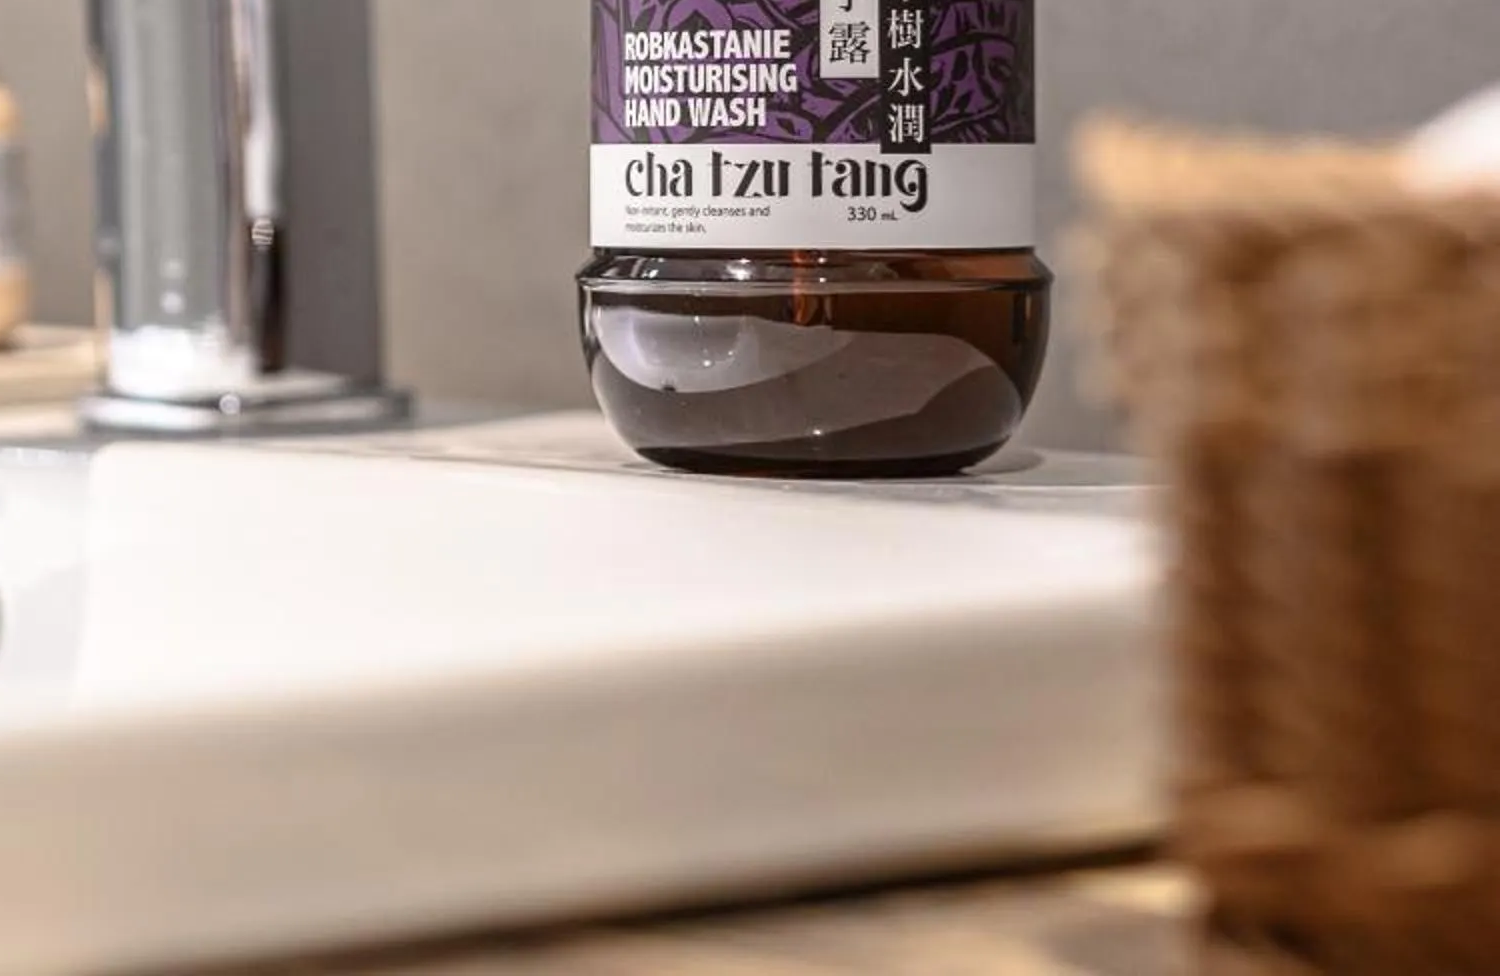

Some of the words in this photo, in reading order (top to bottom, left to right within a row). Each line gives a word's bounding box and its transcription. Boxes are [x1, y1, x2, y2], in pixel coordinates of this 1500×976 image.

[625, 29, 791, 61] ROBKASTANIE
[625, 63, 797, 94] MOISTURISING
[625, 97, 681, 127] HAND
[688, 97, 766, 127] WASH
[625, 151, 693, 197] cha
[708, 151, 791, 198] tzu
[809, 151, 928, 213] tang
[702, 205, 746, 217] cleanses
[749, 205, 771, 217] and
[847, 206, 877, 221] 330
[881, 209, 899, 221] mL
